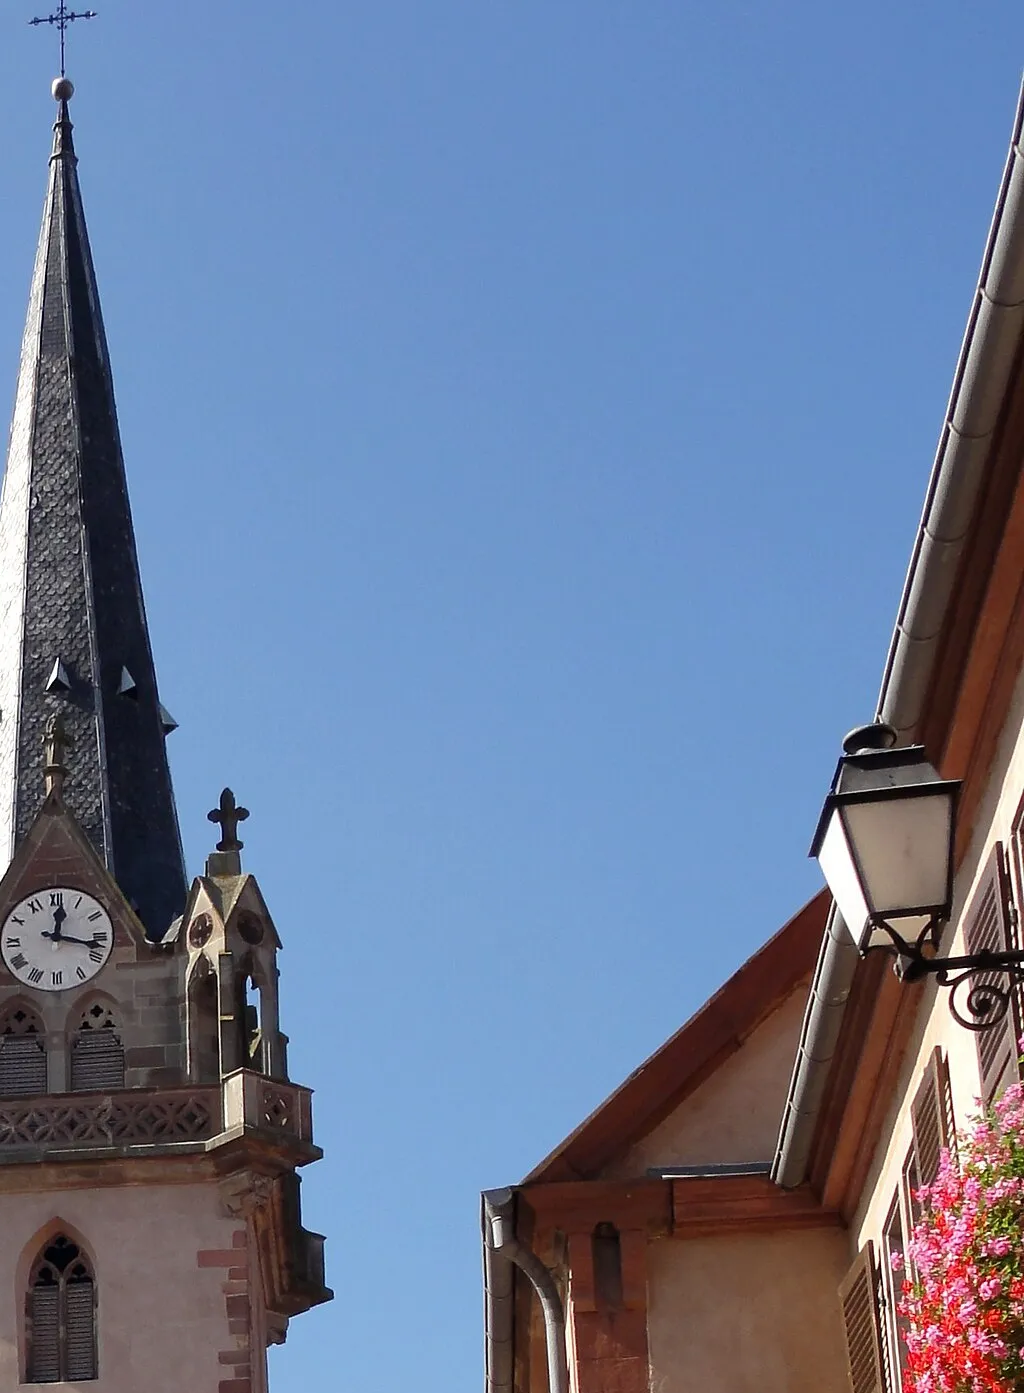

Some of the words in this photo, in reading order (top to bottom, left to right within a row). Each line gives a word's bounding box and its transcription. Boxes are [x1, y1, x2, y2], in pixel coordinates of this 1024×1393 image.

[27, 899, 43, 914] XI
[11, 916, 25, 926] X
[6, 937, 21, 948] IX
